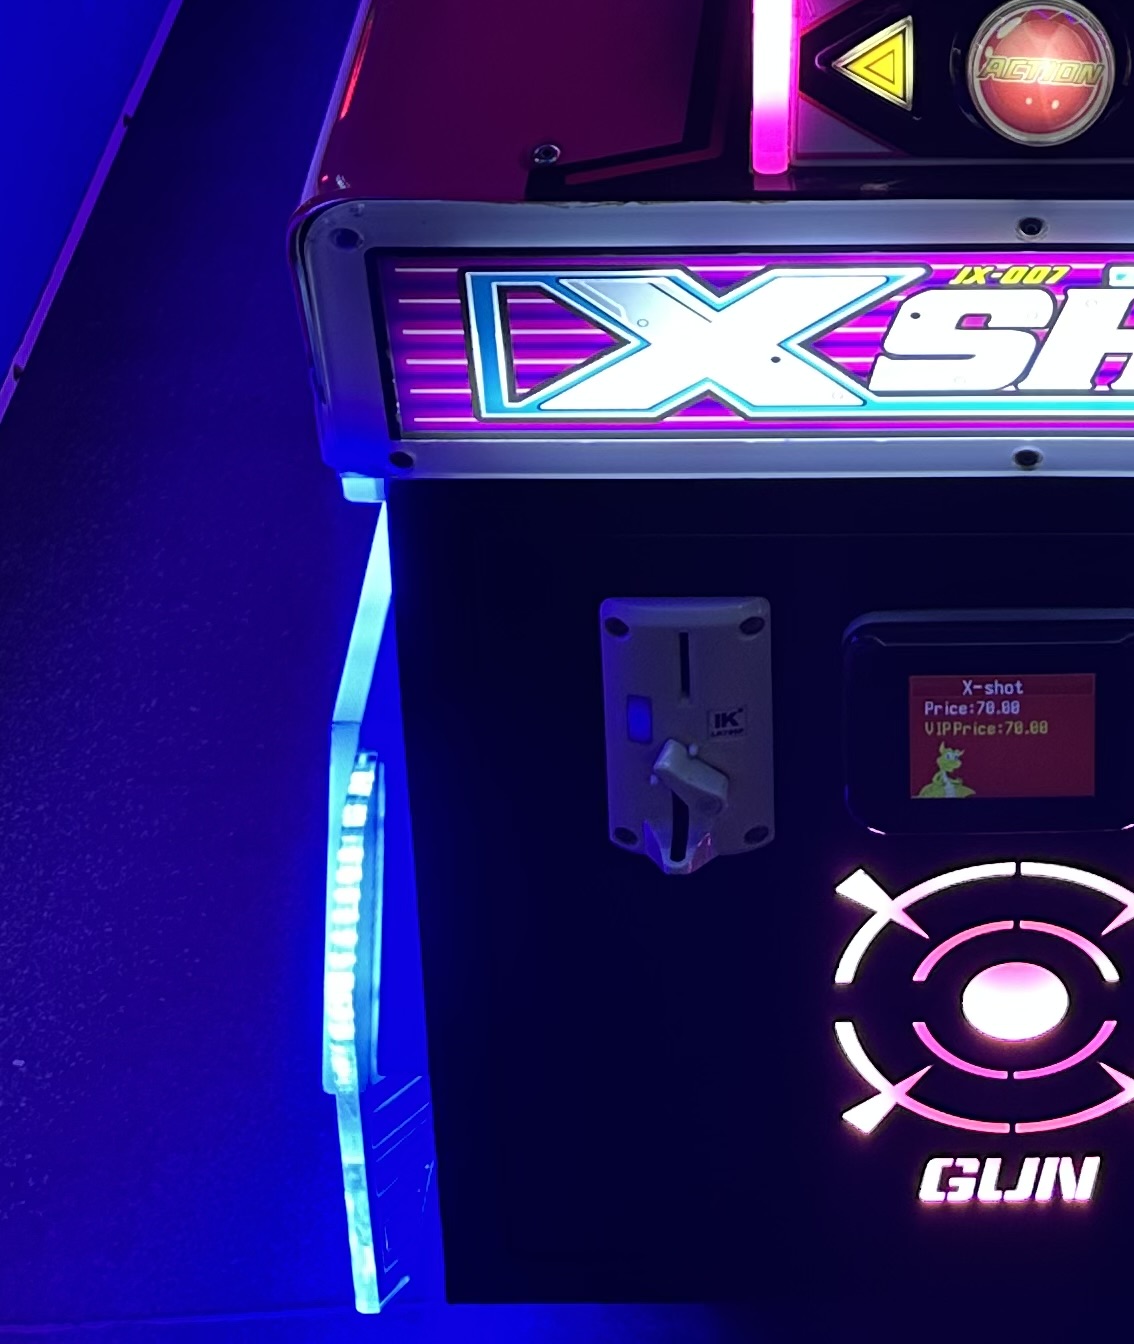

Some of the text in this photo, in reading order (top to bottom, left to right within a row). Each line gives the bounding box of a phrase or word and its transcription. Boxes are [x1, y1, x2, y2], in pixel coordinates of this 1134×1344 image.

[976, 56, 1104, 86] ACTION
[540, 272, 892, 410] X
[962, 679, 1024, 696] X-shot
[924, 700, 1020, 716] Price:70.00
[919, 1156, 1101, 1204] GUN
